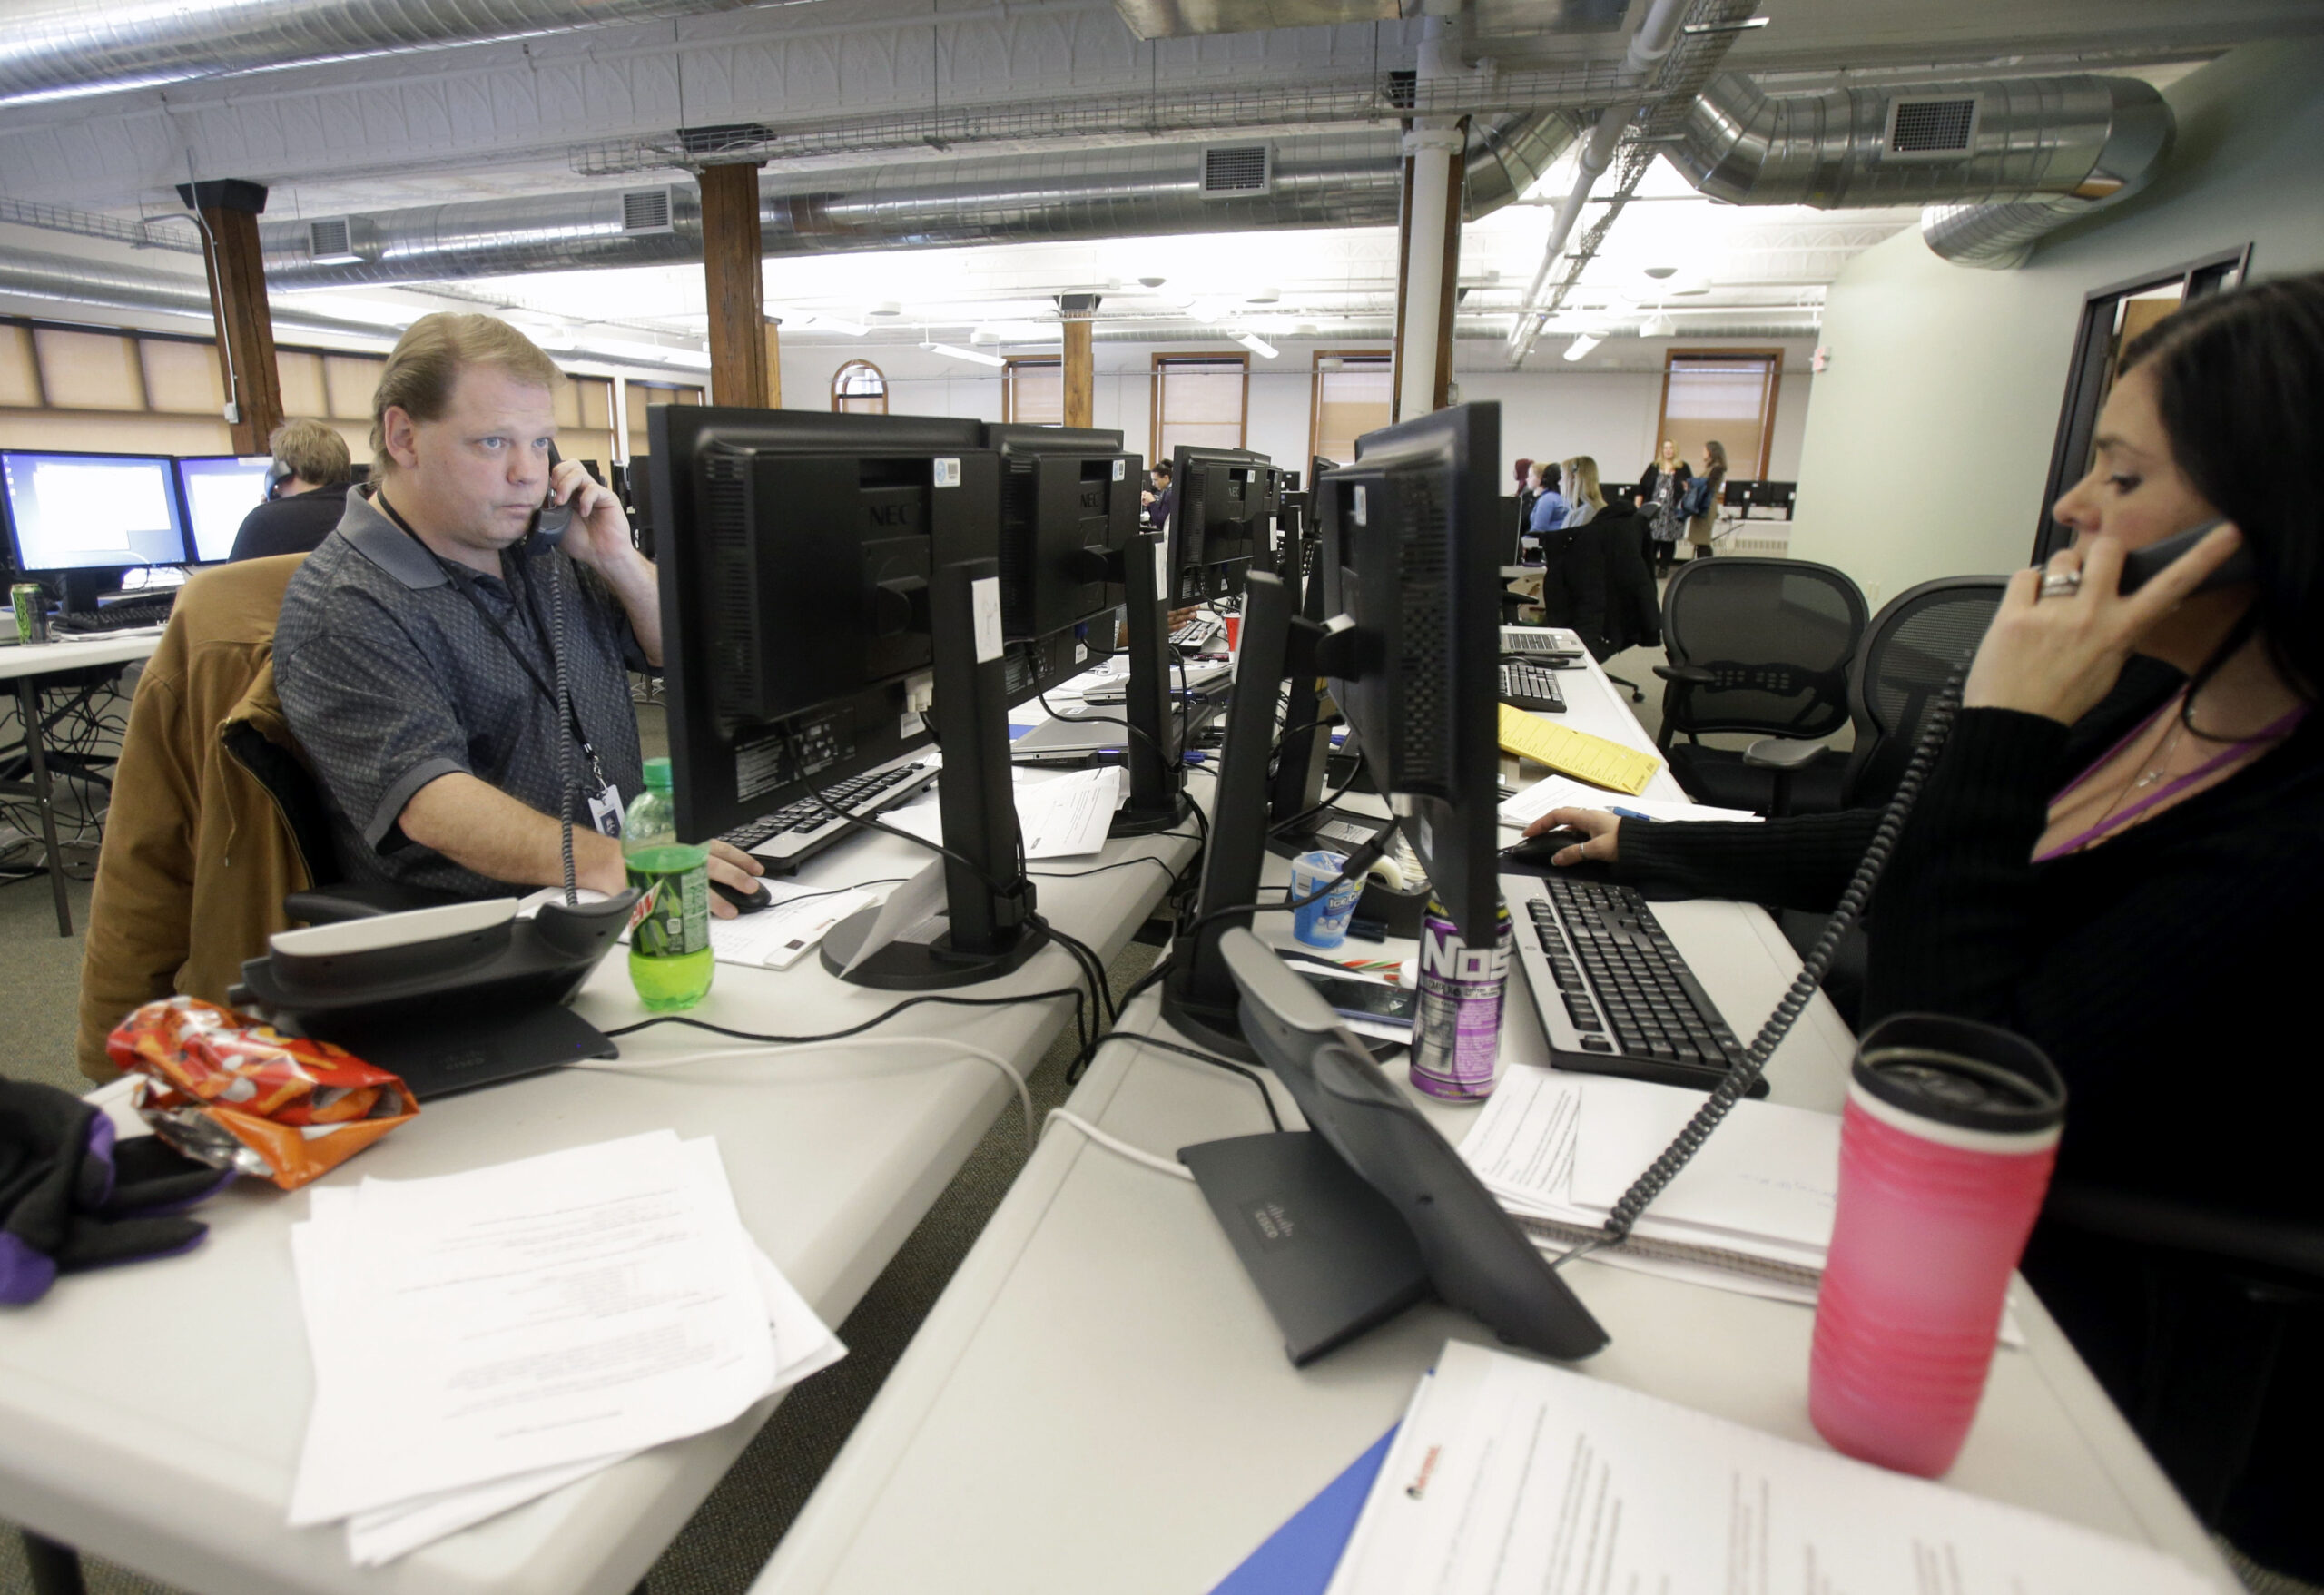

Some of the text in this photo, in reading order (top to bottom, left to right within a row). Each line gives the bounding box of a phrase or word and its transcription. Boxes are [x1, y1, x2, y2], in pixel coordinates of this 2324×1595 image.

[1080, 492, 1099, 508] NEC
[870, 503, 911, 526] NEC
[1422, 927, 1511, 981] NOS
